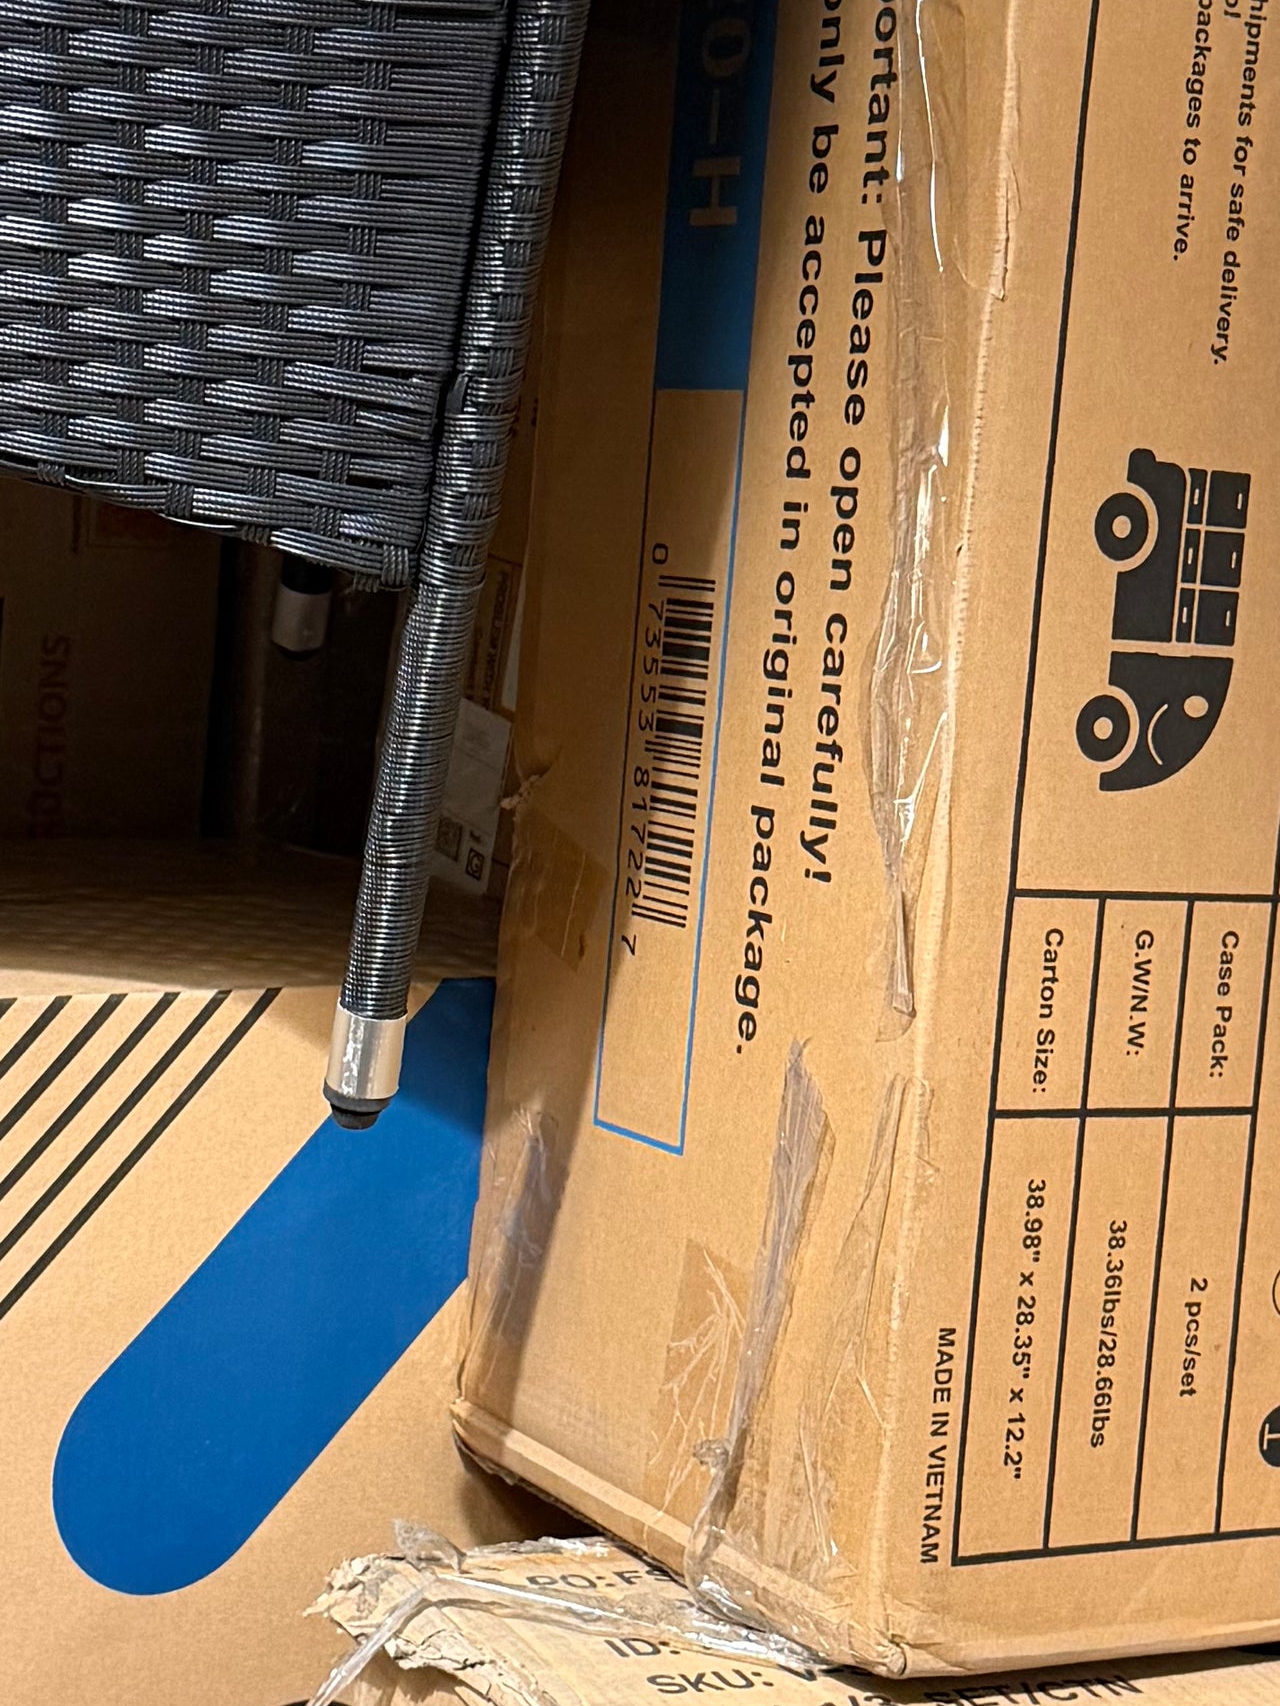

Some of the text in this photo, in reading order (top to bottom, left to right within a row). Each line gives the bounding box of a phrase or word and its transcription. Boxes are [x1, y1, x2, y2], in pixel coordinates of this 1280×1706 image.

[808, 123, 839, 194] be
[1225, 181, 1246, 242] safe
[1231, 134, 1254, 177] for
[784, 214, 825, 479] accepted
[843, 228, 888, 426] Please
[1209, 249, 1241, 365] delivery.
[779, 500, 809, 550] in
[828, 445, 861, 591] open
[620, 541, 669, 957] 0 73553 81722 7
[759, 570, 798, 787] original
[798, 611, 848, 883] carefully!
[733, 803, 776, 1055] package.
[1125, 928, 1155, 1056] G.W/N.W:
[1208, 929, 1240, 1078] Case Pack:
[1031, 927, 1065, 1093] Carton Size:
[1002, 1178, 1047, 1480] 38.98" x 28.35" x 12.2"
[1089, 1219, 1128, 1449] 38.36lbs/28.66lbs
[1178, 1276, 1209, 1397] 2 pcs/set
[918, 1326, 957, 1564] MADE IN VIETNAM
[604, 1637, 680, 1658] ID:
[646, 1668, 774, 1694] SKU:
